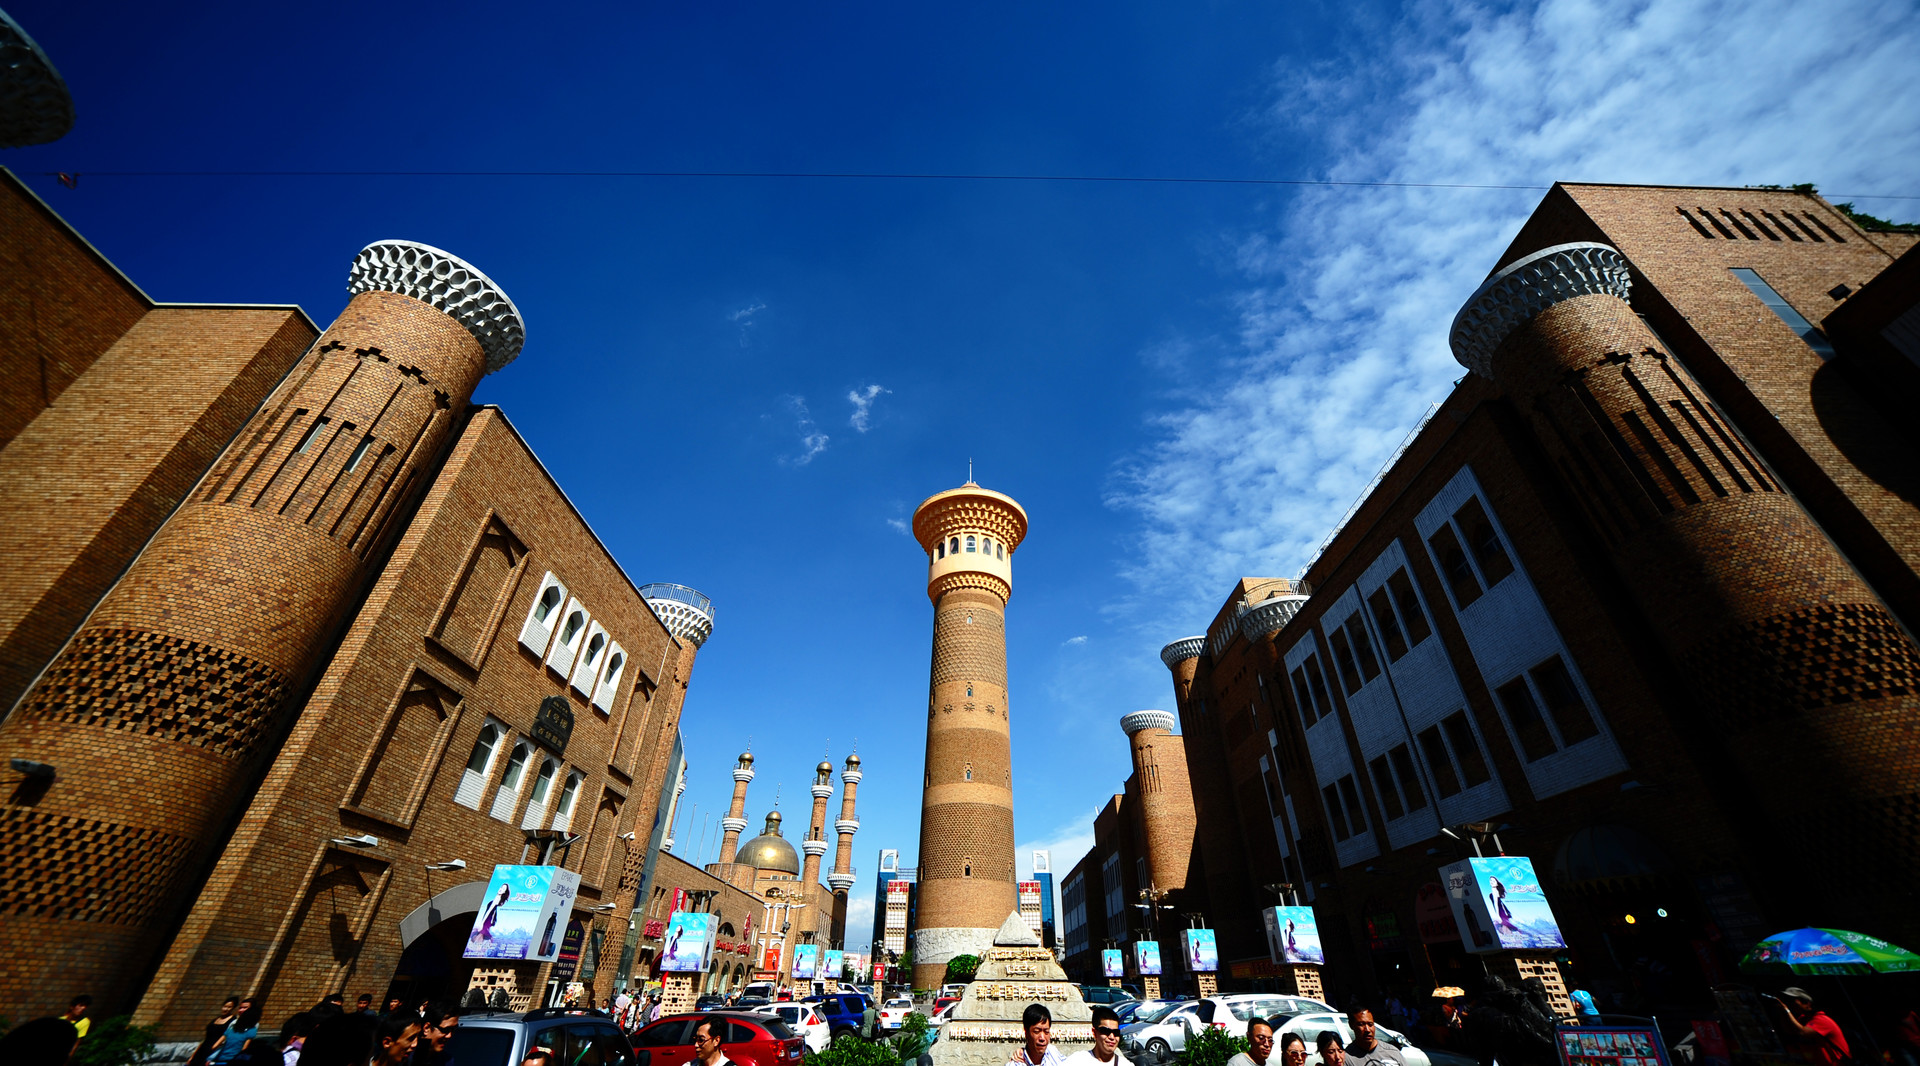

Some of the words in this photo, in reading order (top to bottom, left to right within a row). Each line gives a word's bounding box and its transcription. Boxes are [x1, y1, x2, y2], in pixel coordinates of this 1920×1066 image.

[976, 984, 1070, 1000] 新疆国际大巴扎
